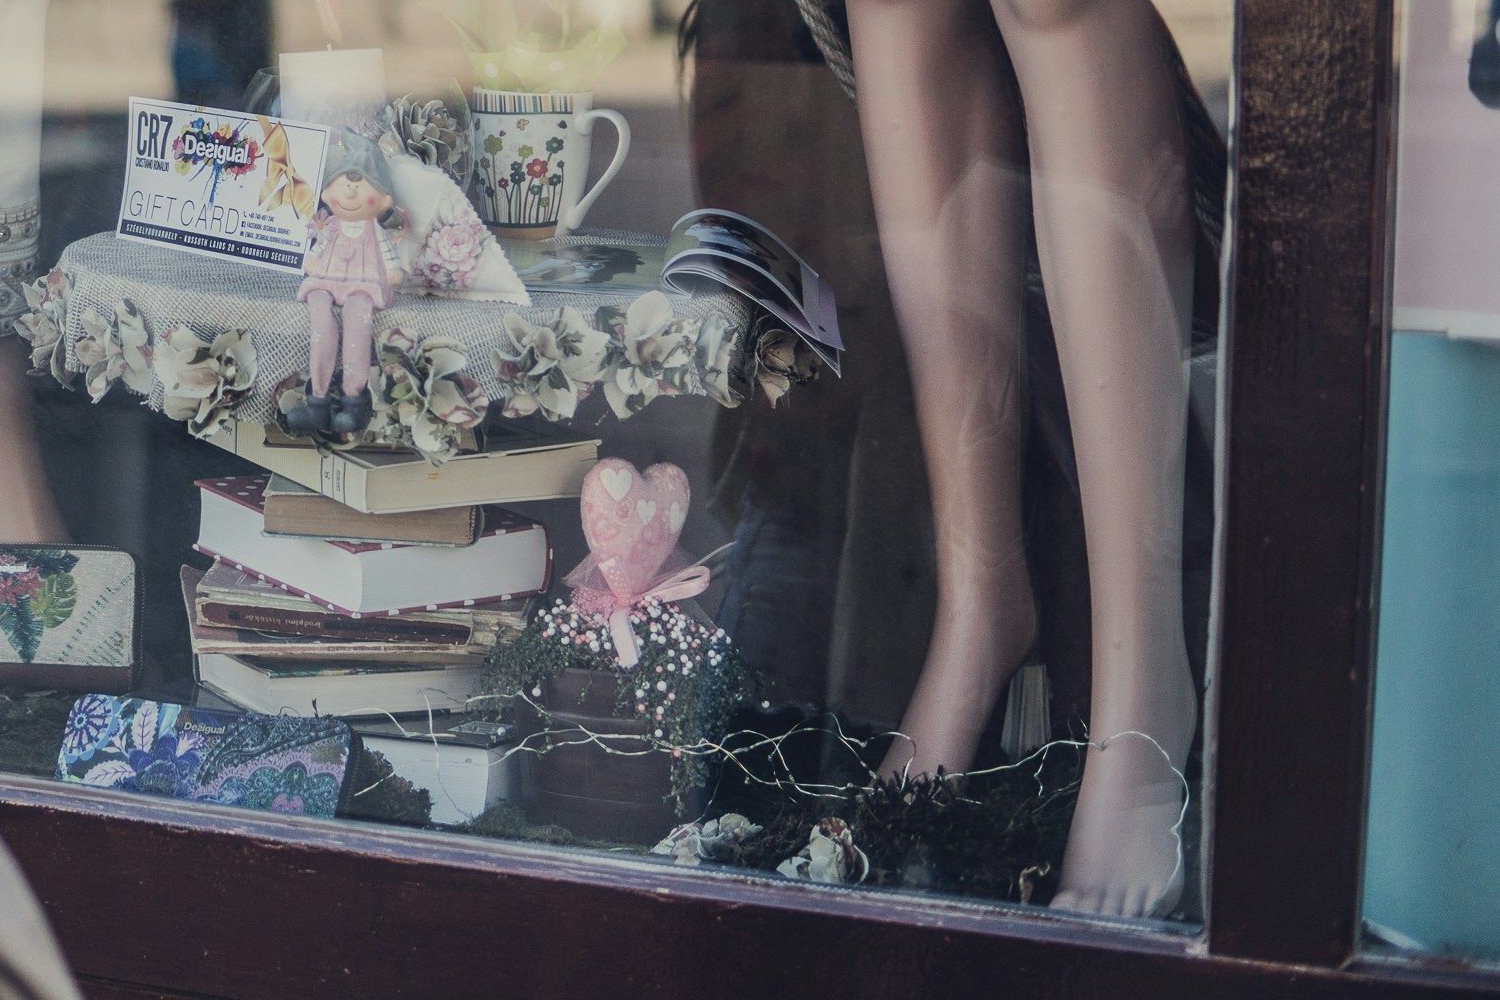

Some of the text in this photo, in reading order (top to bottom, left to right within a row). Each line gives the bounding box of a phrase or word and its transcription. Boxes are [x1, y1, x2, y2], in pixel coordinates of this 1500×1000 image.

[137, 111, 173, 159] CR7
[184, 134, 248, 165] Desigual
[129, 190, 240, 235] GIFT CARD
[183, 235, 208, 247] KOSSUTH
[209, 239, 226, 250] LAJOS
[241, 246, 270, 259] ODORHEIU
[271, 252, 299, 264] SECUIESC
[183, 721, 226, 735] Desigual
